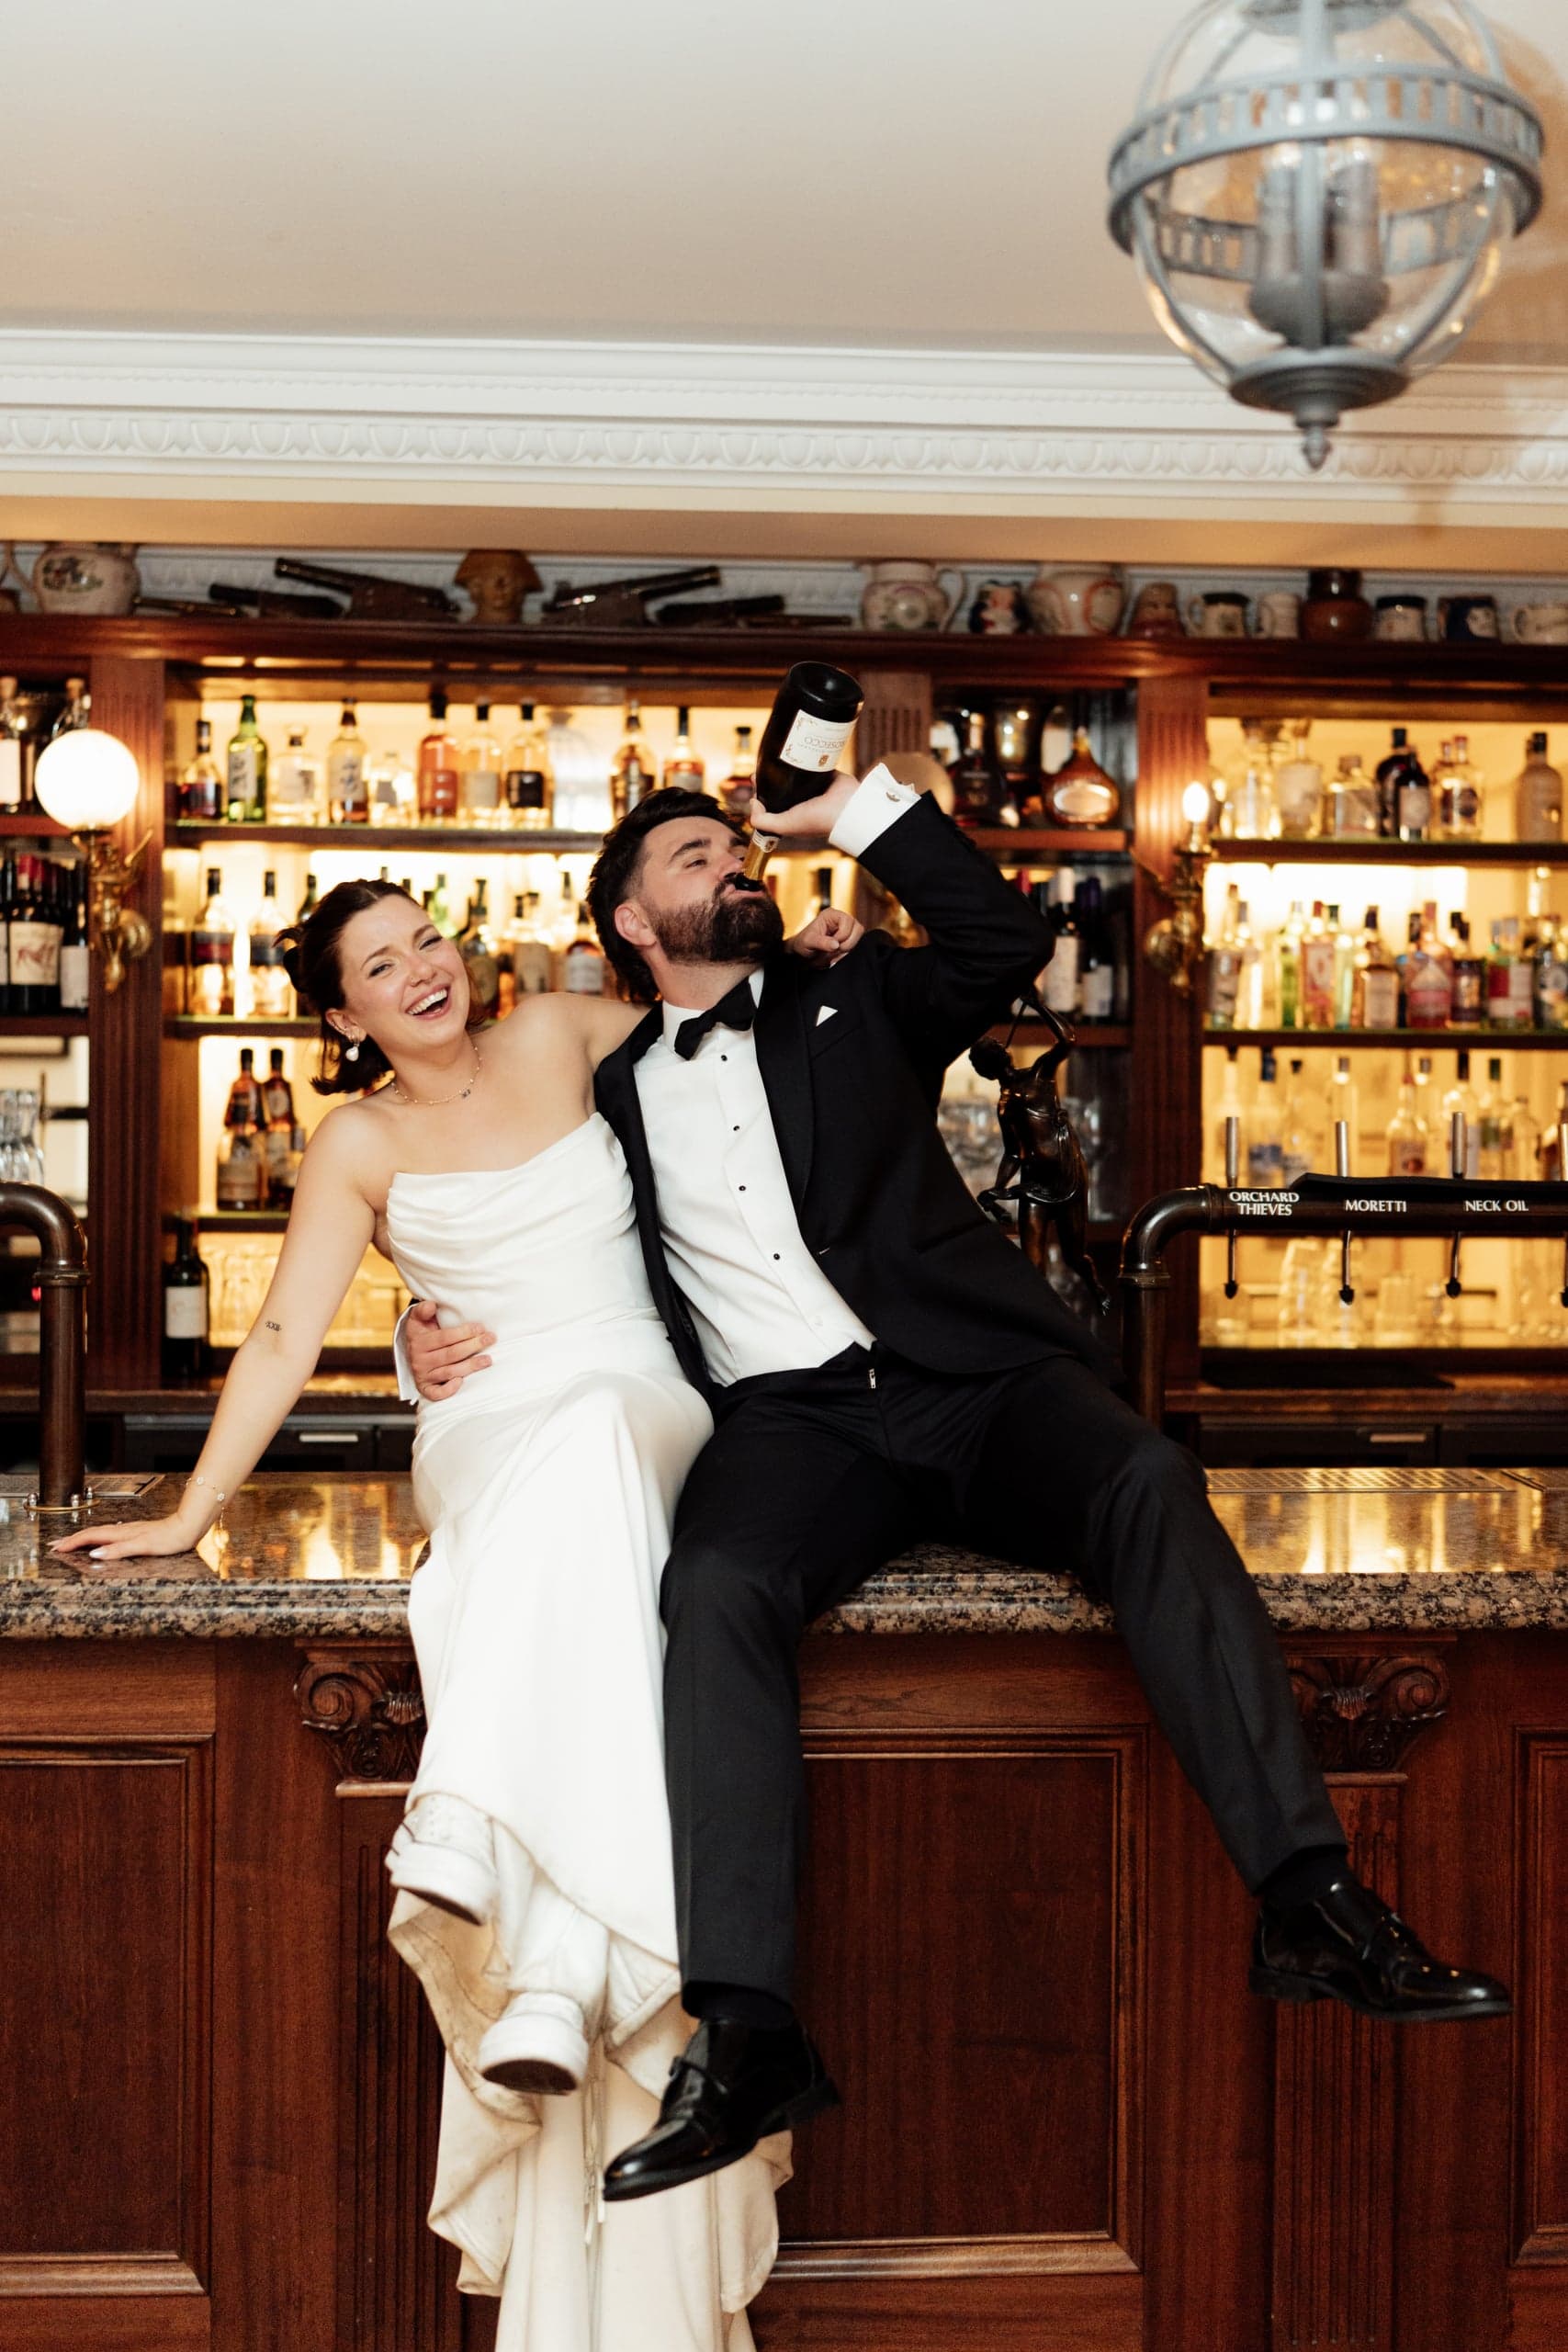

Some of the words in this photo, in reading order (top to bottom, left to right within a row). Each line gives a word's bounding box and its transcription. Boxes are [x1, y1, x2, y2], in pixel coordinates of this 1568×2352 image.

[1229, 1192, 1300, 1203] ORCHARD
[1236, 1203, 1292, 1216] THIEVES
[1345, 1199, 1407, 1213] MORETTI
[1464, 1199, 1501, 1212] NECK
[1506, 1199, 1529, 1212] OIL
